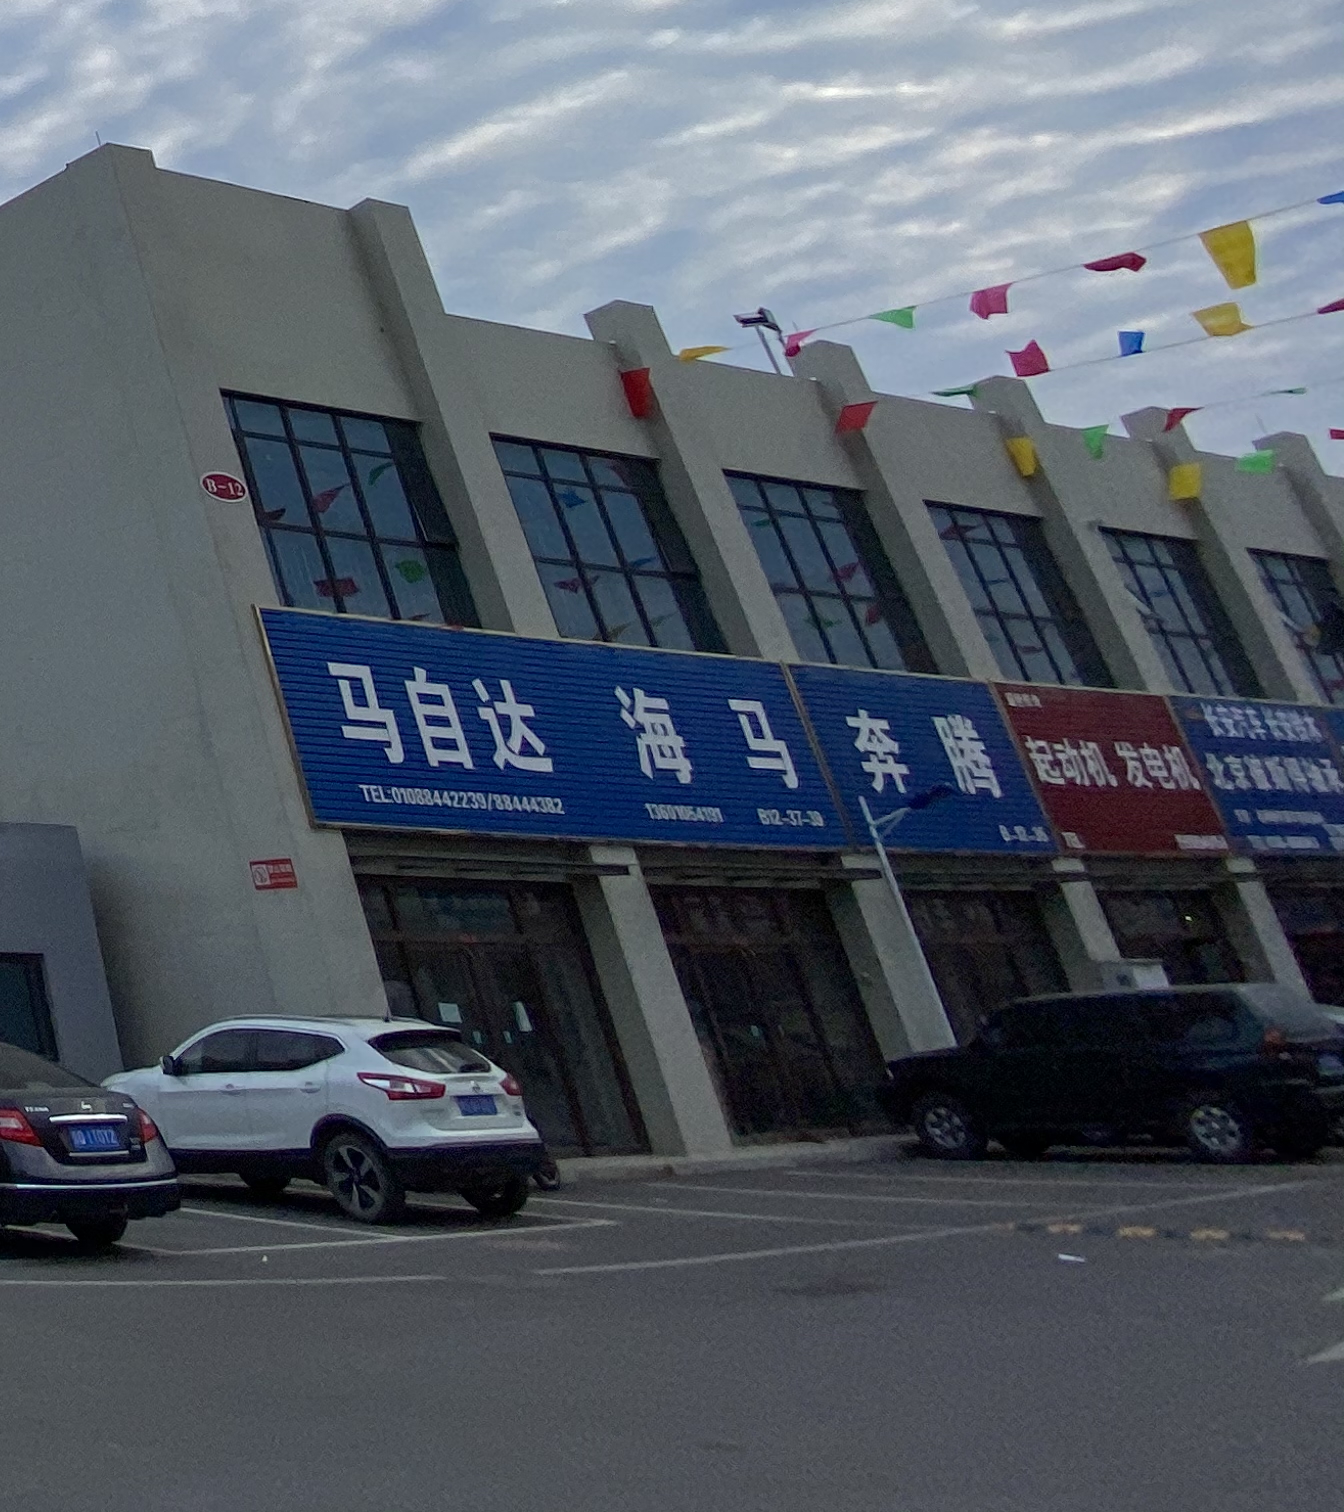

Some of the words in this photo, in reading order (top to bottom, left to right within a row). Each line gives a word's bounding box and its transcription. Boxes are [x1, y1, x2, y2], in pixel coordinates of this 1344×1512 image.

[206, 478, 244, 496] B-12
[327, 662, 554, 773] 马自达
[615, 686, 800, 789] 海马
[846, 708, 1003, 799] 奔腾
[1025, 735, 1118, 787] 起动机
[1114, 742, 1202, 790] 发电机
